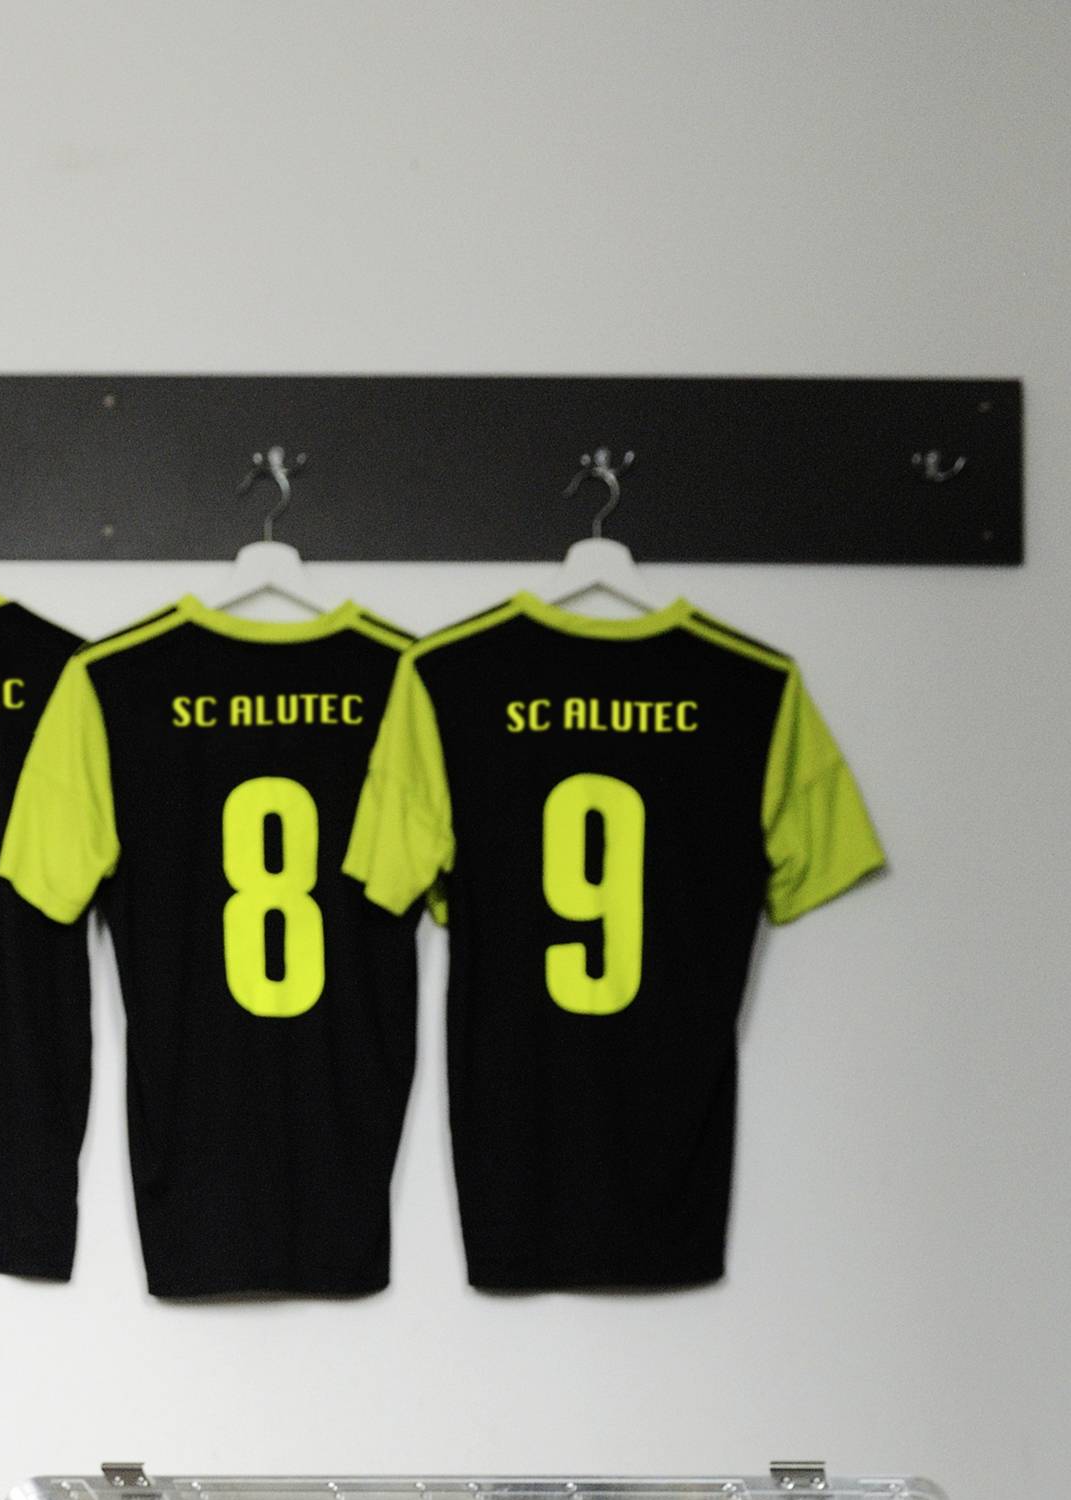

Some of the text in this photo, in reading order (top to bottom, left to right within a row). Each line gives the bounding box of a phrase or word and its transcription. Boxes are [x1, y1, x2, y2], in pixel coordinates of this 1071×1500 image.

[171, 693, 364, 728] SC ALUTEC
[505, 697, 699, 734] SC ALUTEC
[222, 776, 326, 1018] 8
[542, 773, 646, 1016] 9
